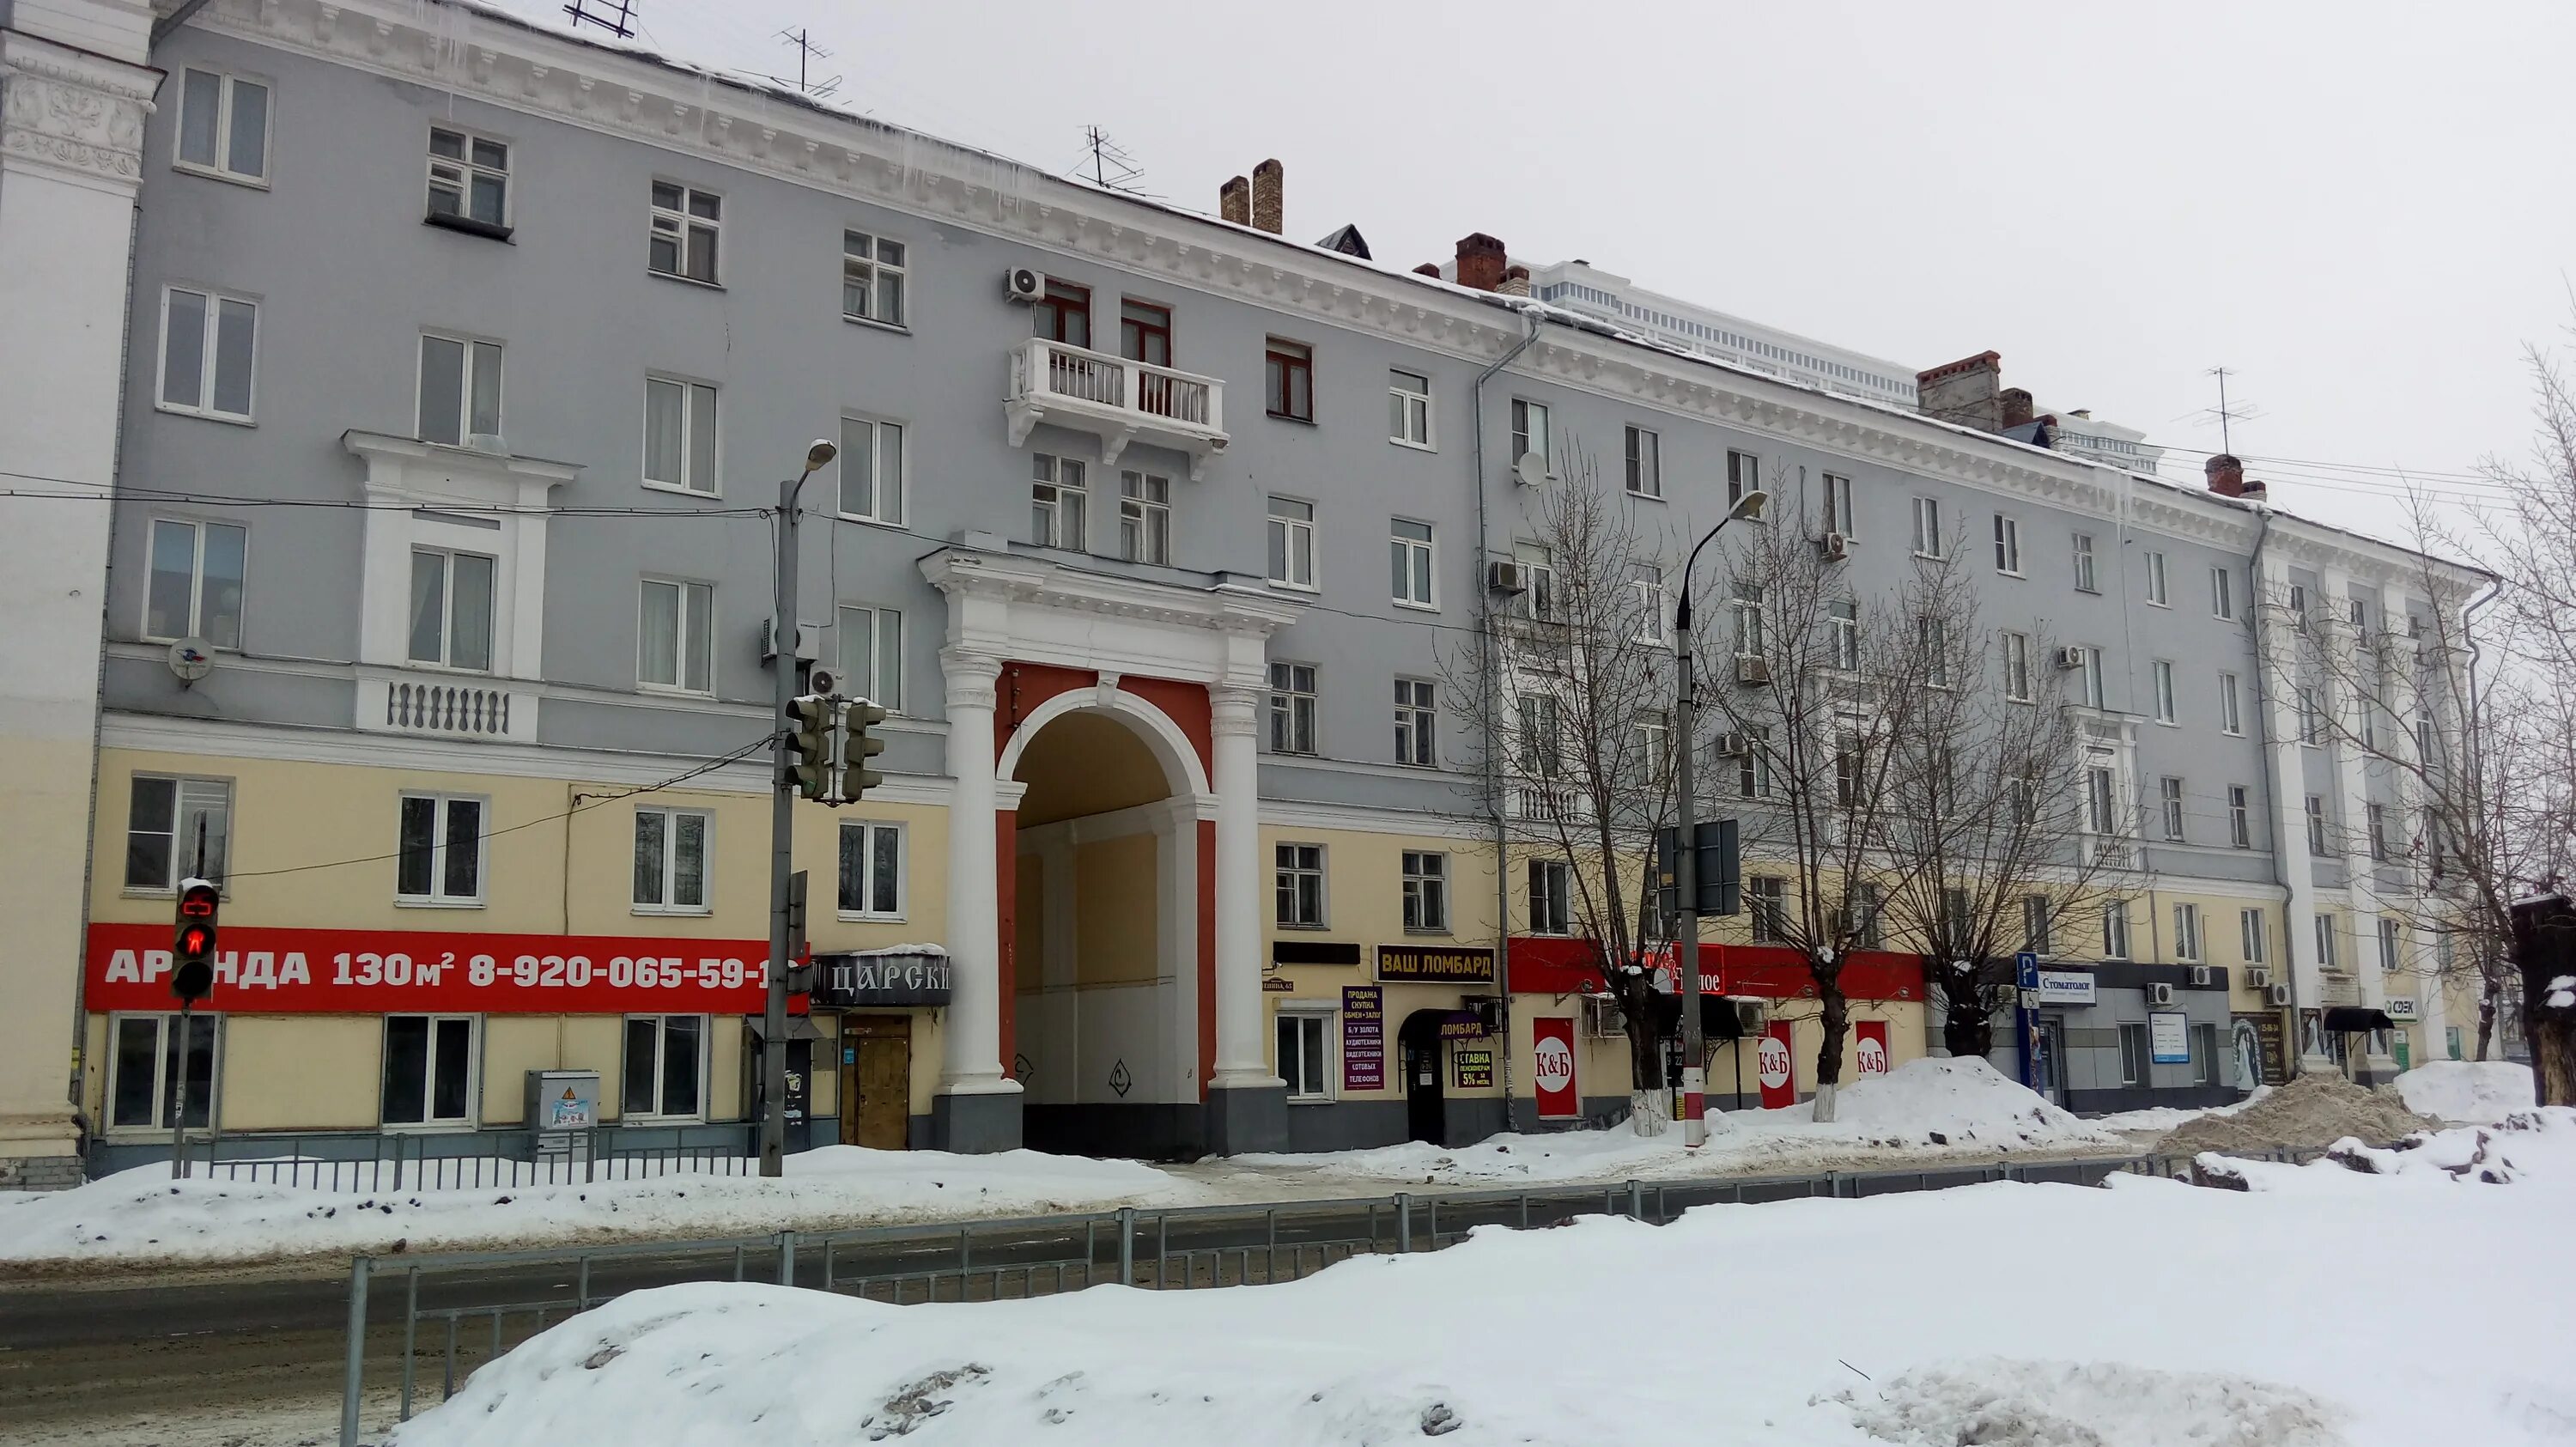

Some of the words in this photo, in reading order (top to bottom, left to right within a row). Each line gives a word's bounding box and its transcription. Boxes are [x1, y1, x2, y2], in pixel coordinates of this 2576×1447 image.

[105, 949, 311, 989] АРНДА
[468, 954, 799, 989] 8-920-065-59-1
[1382, 953, 1418, 973] ВАШ
[1422, 954, 1492, 977] ЛОМБАРД
[2043, 977, 2090, 990] Стоматолог
[1347, 990, 1378, 1000] ПРОДАЖА
[2393, 1000, 2414, 1013] CDEK
[1441, 1022, 1483, 1036] ЛОМБАРД
[1460, 1053, 1490, 1064] СТАВКА
[1535, 1052, 1570, 1077] К&Б
[1759, 1051, 1788, 1074] К&Б
[1857, 1051, 1884, 1073] К&Б
[1462, 1073, 1476, 1085] 5%
